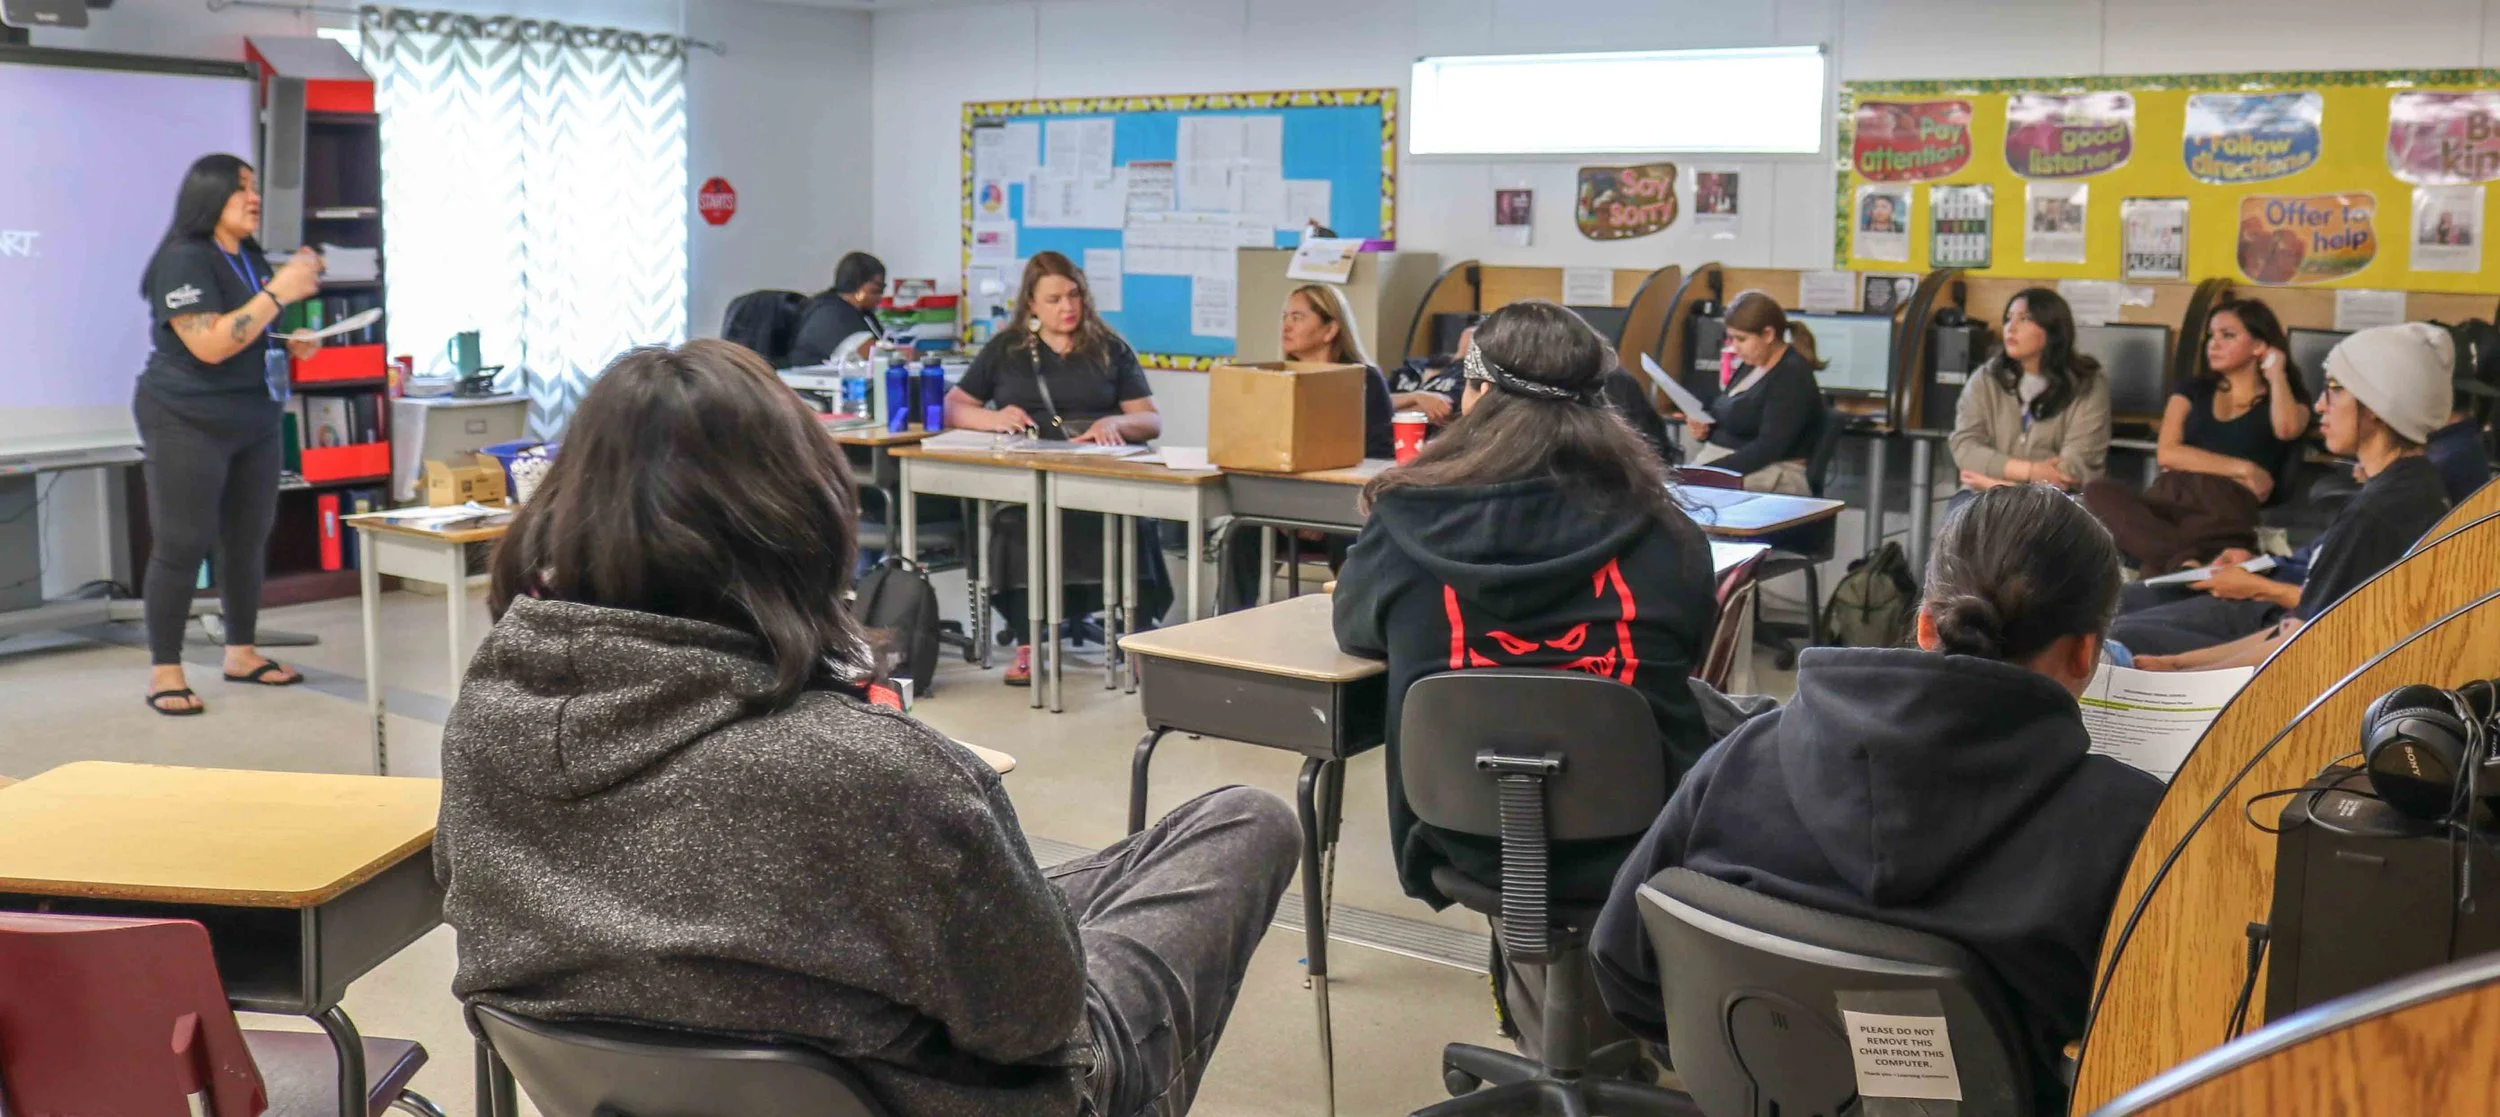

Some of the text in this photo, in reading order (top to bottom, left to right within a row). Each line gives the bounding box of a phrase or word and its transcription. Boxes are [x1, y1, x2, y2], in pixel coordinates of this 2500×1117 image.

[1920, 115, 1962, 143] Pay
[2061, 121, 2125, 153] good
[2466, 110, 2500, 141] B
[2210, 134, 2292, 156] Follow
[1861, 146, 1965, 173] attention
[2029, 147, 2120, 175] listener
[2192, 151, 2312, 180] directions
[1621, 168, 1669, 199] Say
[1609, 199, 1675, 226] sorry
[2265, 199, 2369, 226] Offer to
[2314, 229, 2368, 253] help
[2404, 745, 2421, 777] SONY
[1860, 1026, 1935, 1037] PLEASE DO NOT
[1867, 1037, 1933, 1047] REMOVE THIS
[1859, 1047, 1945, 1058] CHAIR FROM THIS
[1875, 1059, 1933, 1068] COMPUTER.
